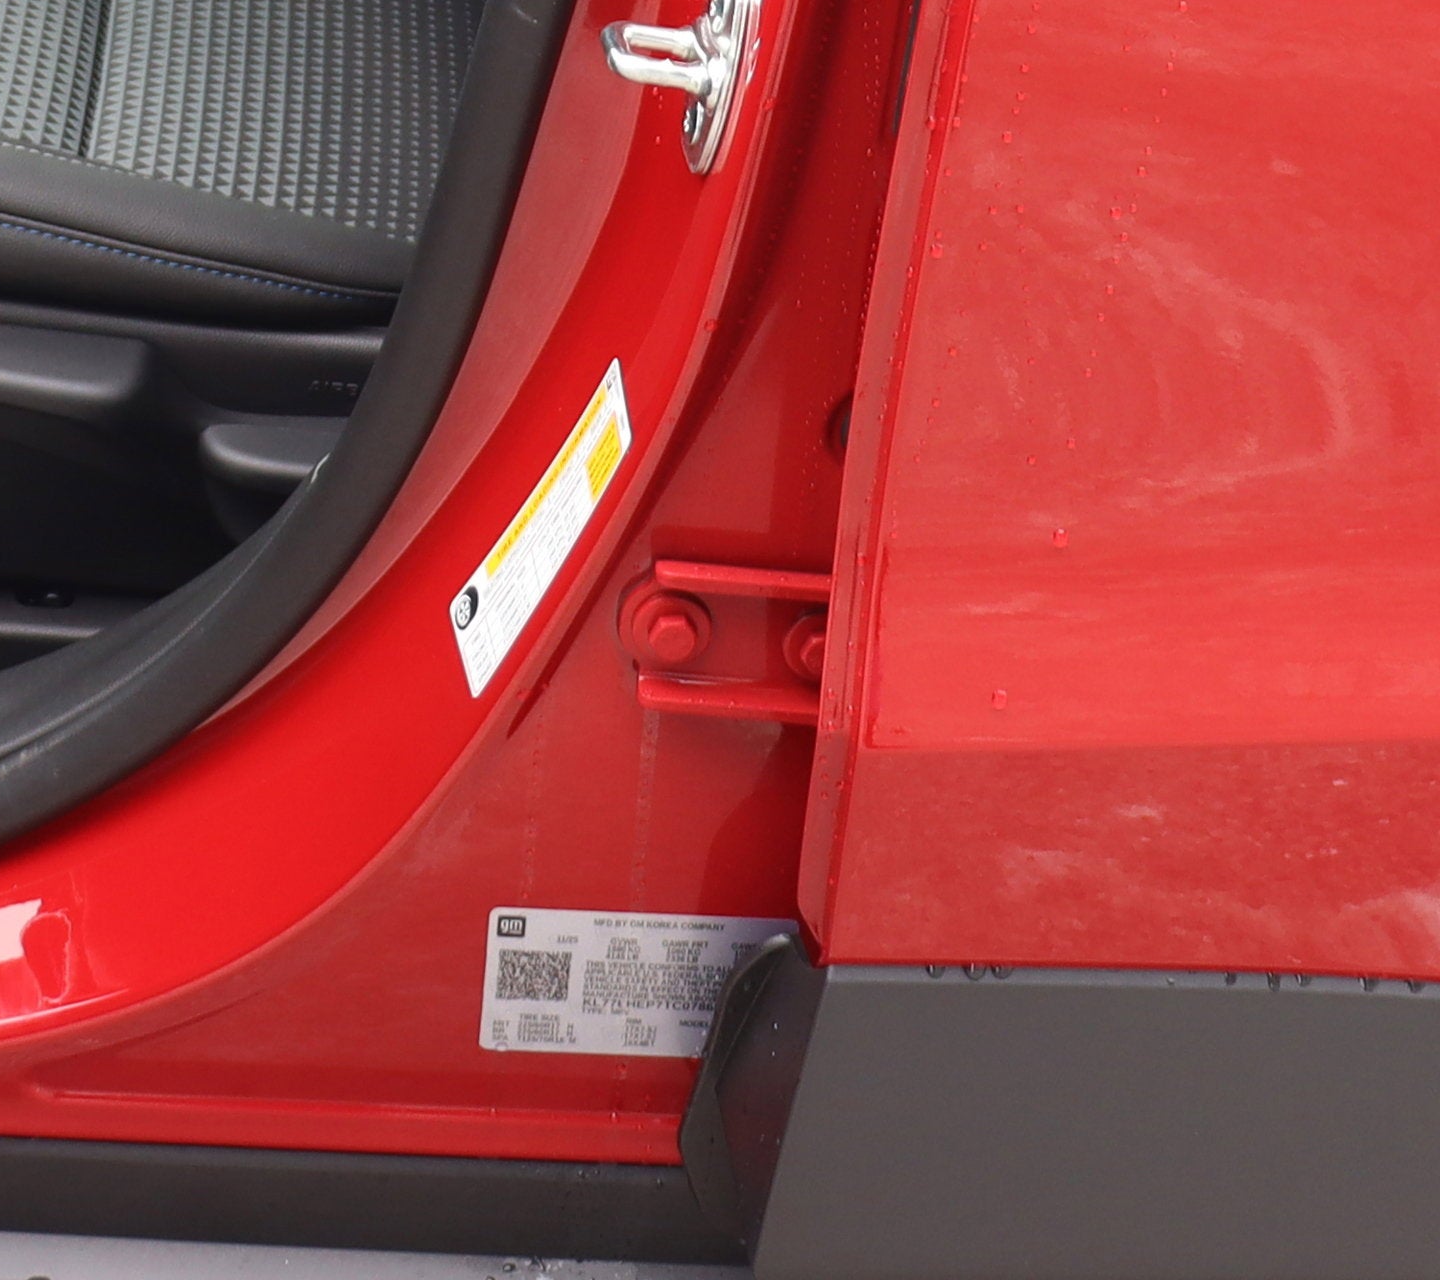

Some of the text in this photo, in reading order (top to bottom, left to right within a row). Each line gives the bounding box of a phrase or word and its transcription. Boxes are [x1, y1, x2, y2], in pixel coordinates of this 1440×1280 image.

[630, 919, 644, 929] GM
[646, 920, 679, 930] KOREA
[681, 922, 725, 931] COMPANY
